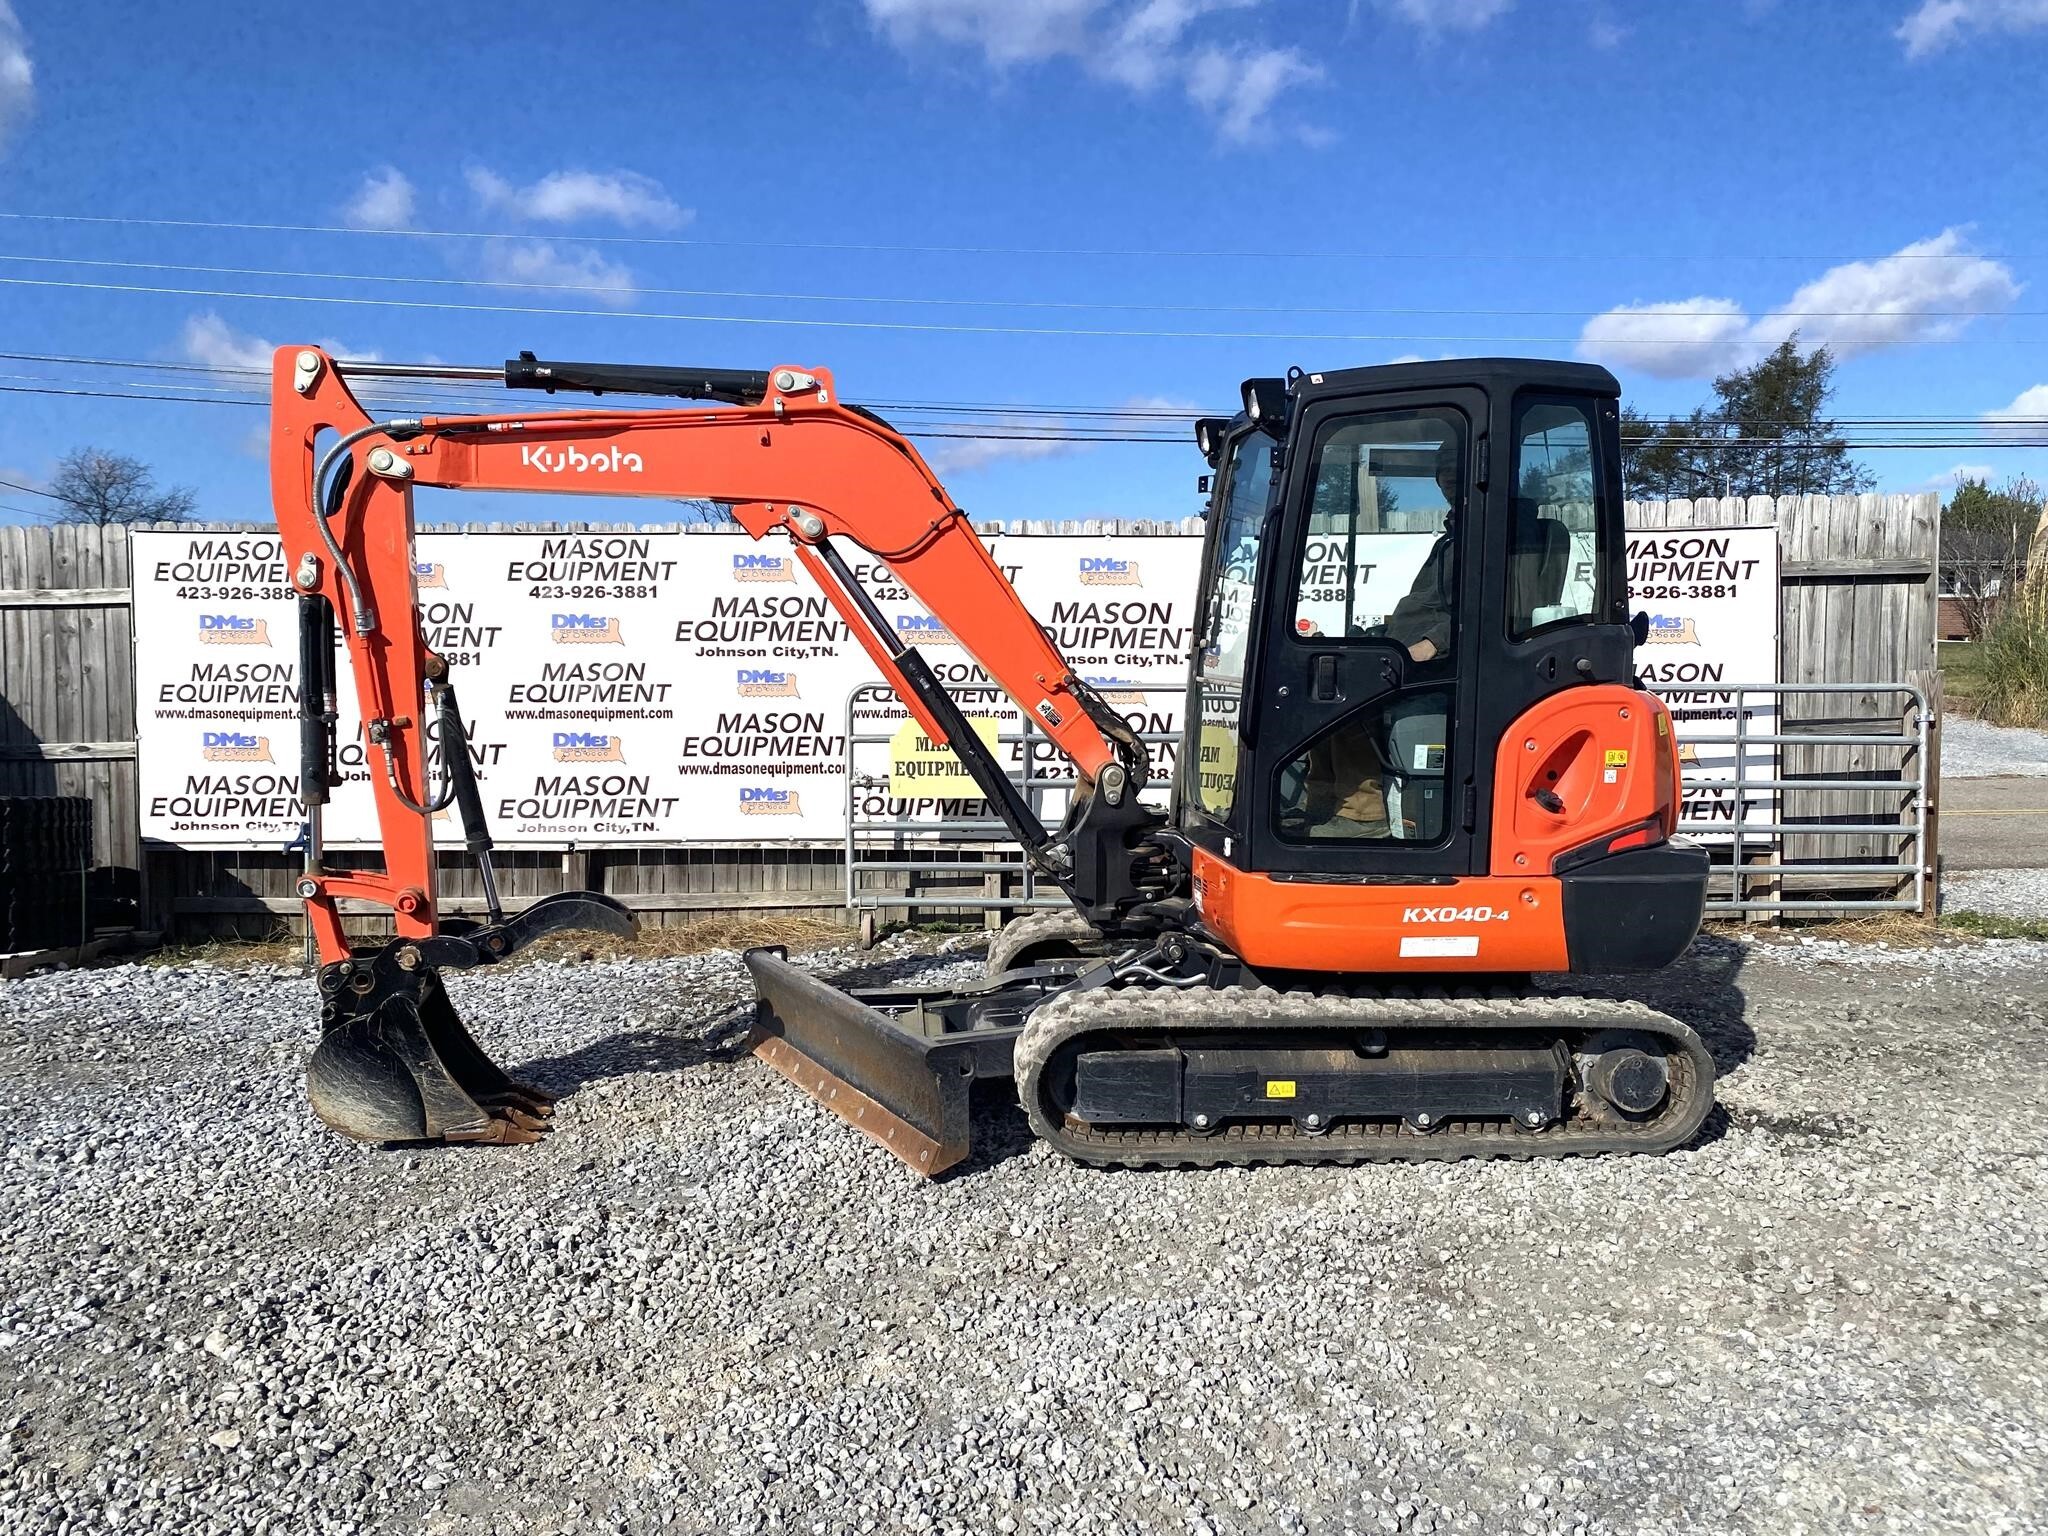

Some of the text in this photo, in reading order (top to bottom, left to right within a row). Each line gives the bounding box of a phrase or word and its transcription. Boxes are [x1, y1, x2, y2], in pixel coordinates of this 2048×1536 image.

[522, 446, 642, 472] Kubota
[541, 539, 650, 559] MASON
[154, 563, 291, 582] EQUIPME
[507, 561, 677, 582] EQUIPMENT
[176, 587, 295, 600] 423-926-388
[529, 585, 658, 599] 423-926-3881
[1627, 585, 1737, 599] 3-926-3881
[711, 597, 828, 618] MASON
[1051, 602, 1173, 625] MASON
[675, 620, 850, 642] EQUIPMENT
[695, 647, 839, 659] Johnson City,TN.
[1067, 653, 1184, 667] nson City,TN.
[191, 663, 293, 682] MASON
[541, 662, 646, 682] MASON
[933, 664, 988, 682] SON
[1639, 663, 1724, 682] ASON
[159, 685, 300, 703] EQUIPMEN
[509, 684, 672, 703] EQUIPMENT
[155, 708, 300, 722] www.dmasonequipment.c
[505, 707, 673, 722] www.dmasonequipment.com
[716, 713, 824, 734] MASON
[678, 762, 845, 776] www.dmasonequipment.co
[895, 761, 971, 779] EQUIPME
[185, 775, 300, 795] MASON
[534, 775, 650, 796] MASON
[150, 798, 308, 817] EQUIPMEN
[497, 798, 679, 819] EQUIPMENT
[170, 822, 240, 831] Johnson
[517, 822, 660, 834] Johnson City,TN.
[1402, 906, 1510, 923] KX040-4
